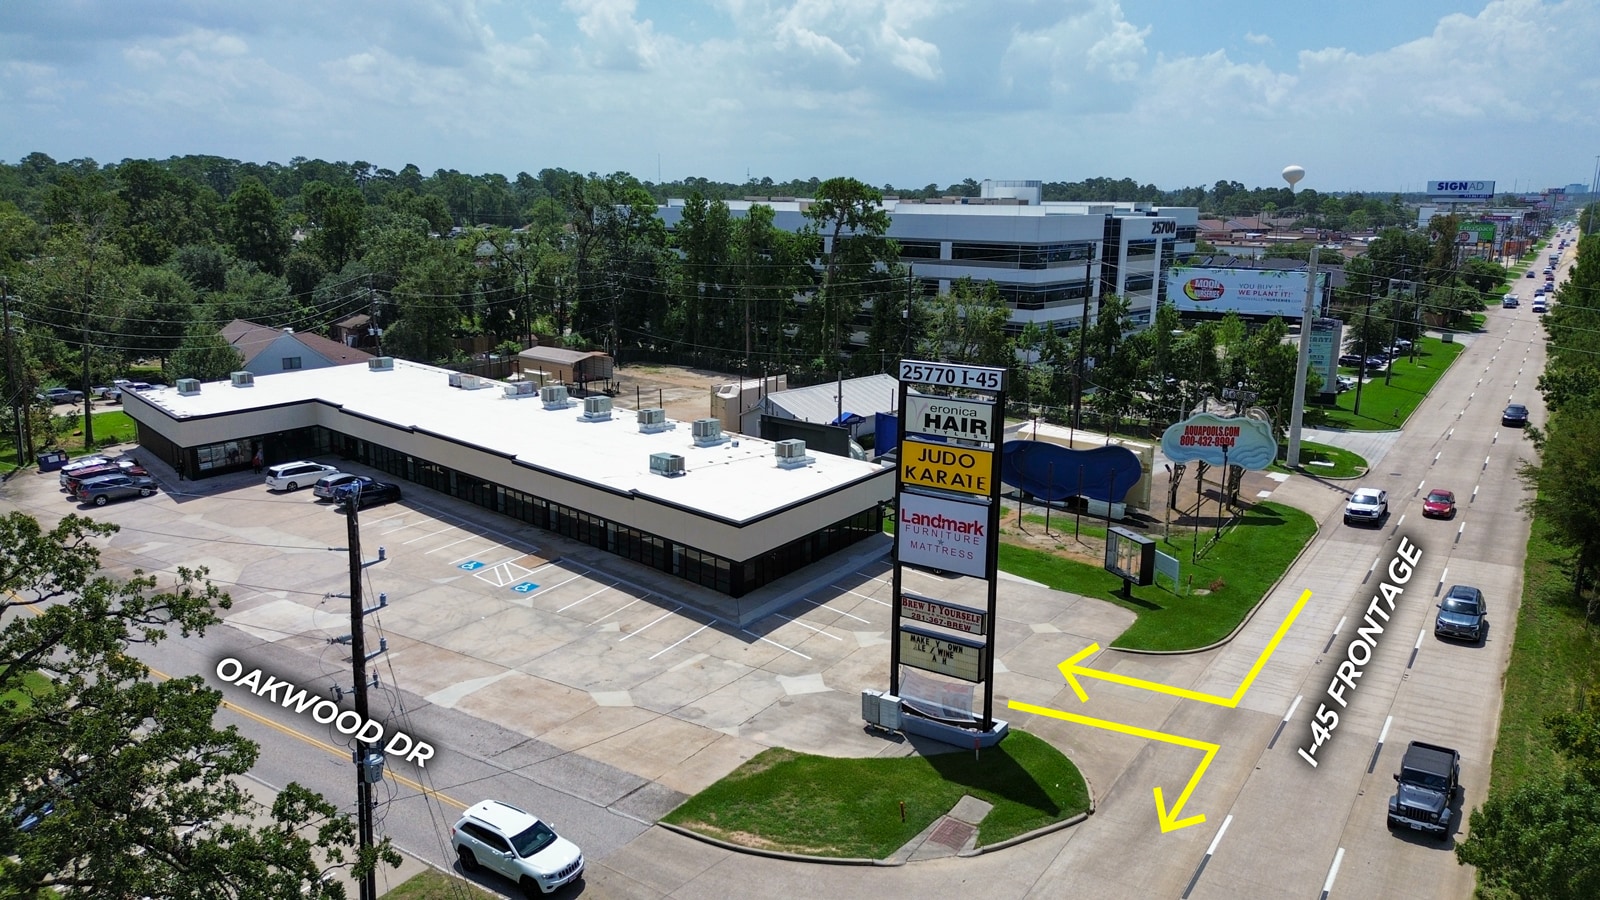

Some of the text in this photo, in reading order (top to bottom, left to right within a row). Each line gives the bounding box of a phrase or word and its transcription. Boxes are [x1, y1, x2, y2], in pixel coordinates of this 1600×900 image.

[1151, 221, 1176, 234] 25700
[1194, 279, 1220, 288] MOON
[902, 364, 998, 388] 25770 I-45
[922, 428, 989, 440] STYLIST
[924, 413, 988, 435] HAIR
[918, 448, 976, 469] JUDO
[905, 465, 987, 491] KARATE
[901, 508, 984, 537] Landmark
[905, 524, 980, 546] FURNITURE
[910, 540, 974, 560] MATTRESS
[902, 597, 924, 611] BREW
[940, 606, 981, 624] YOURSELF
[911, 612, 972, 632] 281-367-BREW
[911, 635, 930, 645] MAKE
[948, 643, 963, 654] OWN
[938, 648, 954, 659] WINE
[932, 654, 937, 662] A
